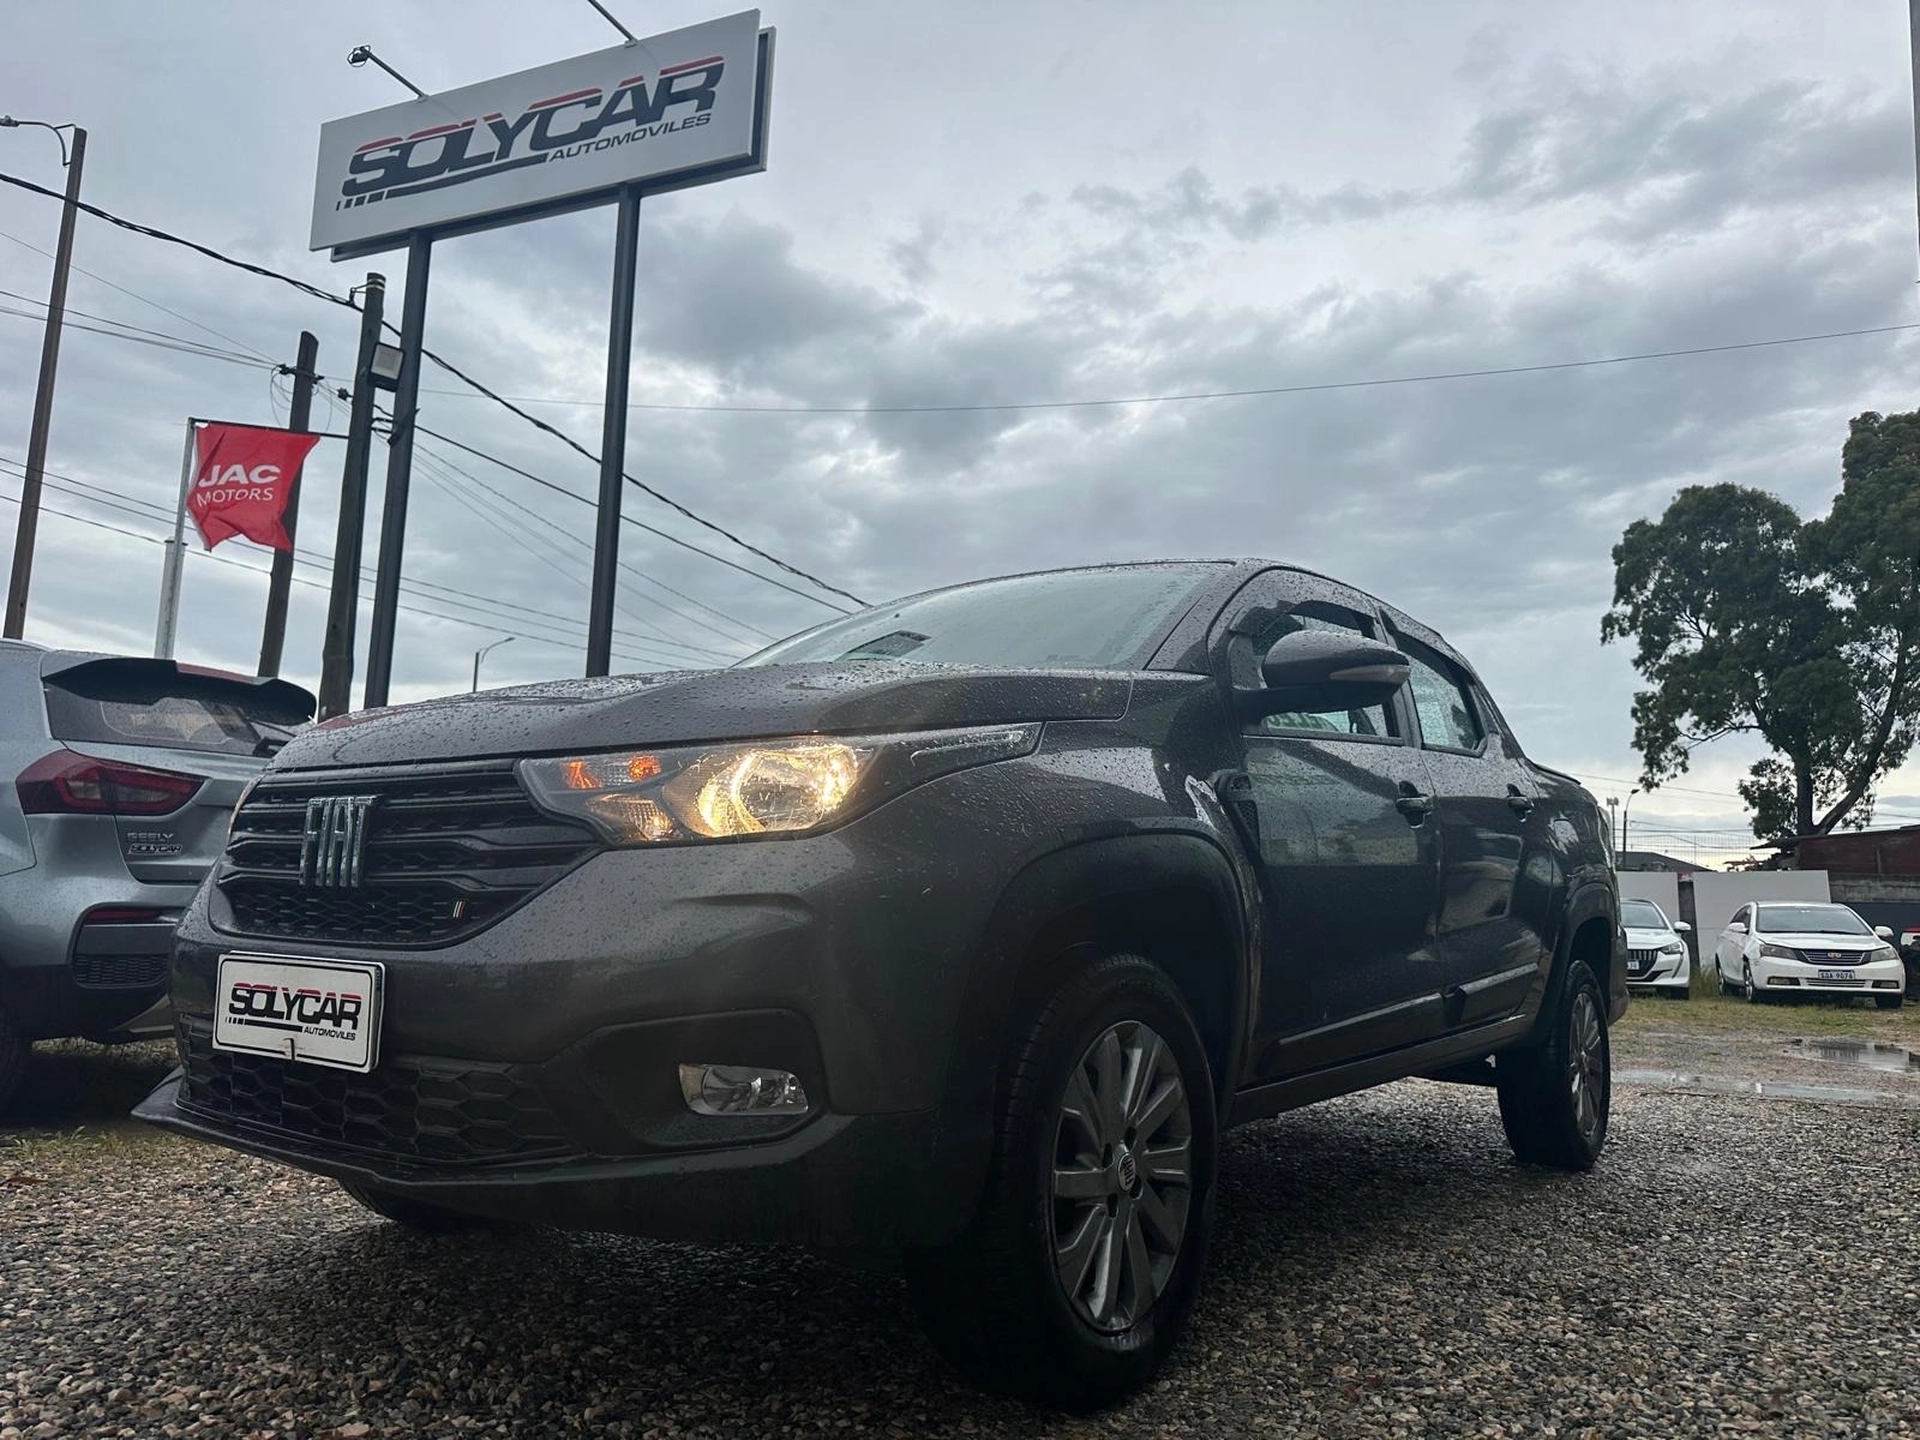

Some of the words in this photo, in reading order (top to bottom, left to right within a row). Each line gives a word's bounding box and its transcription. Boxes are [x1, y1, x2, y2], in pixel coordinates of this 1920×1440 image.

[342, 55, 725, 198] SOLYCAR
[549, 112, 712, 162] AUTOMOVILES
[196, 487, 274, 507] MOTORS
[198, 464, 281, 488] JAC
[299, 795, 375, 887] FIAT
[229, 982, 362, 1030] SOLYCAR
[303, 1026, 356, 1041] AUTOMOVILES
